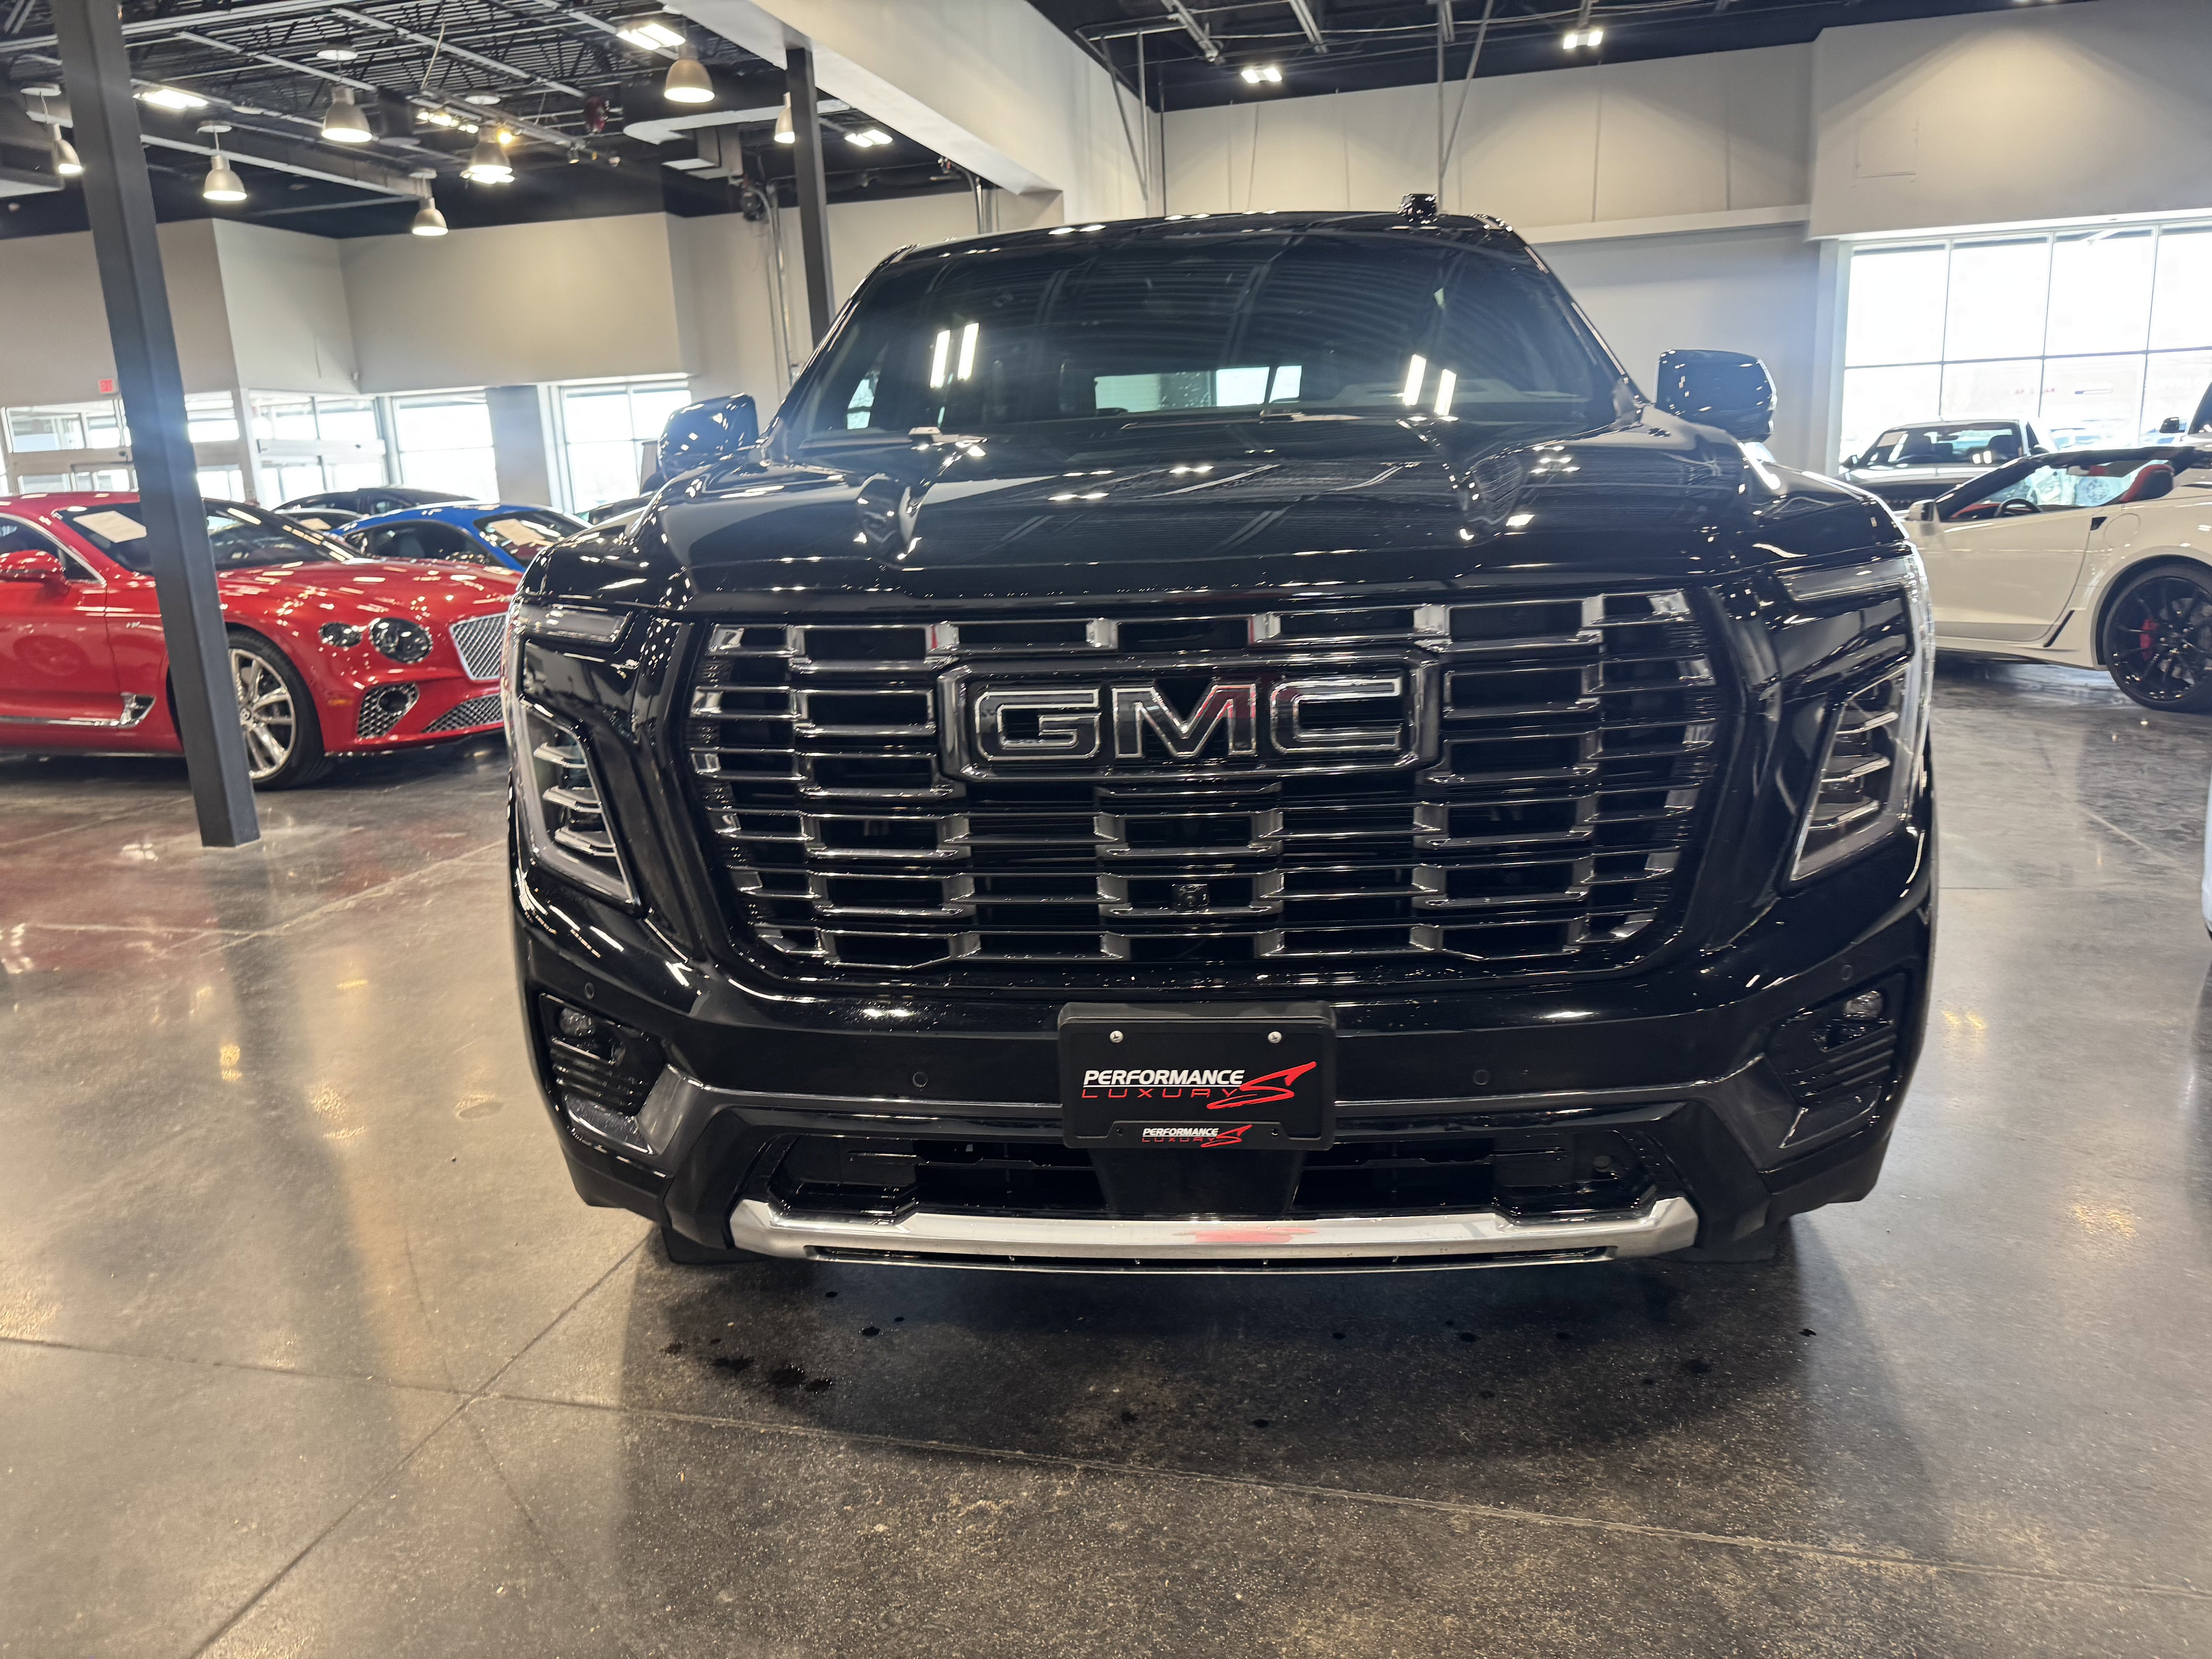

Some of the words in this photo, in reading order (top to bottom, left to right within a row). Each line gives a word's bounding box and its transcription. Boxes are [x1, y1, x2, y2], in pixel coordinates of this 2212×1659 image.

[975, 678, 1403, 761] GMC
[1083, 1070, 1245, 1085] PERFORMANCE
[1082, 1088, 1240, 1098] LUXURY
[1142, 1128, 1219, 1137] PERFORMANCE
